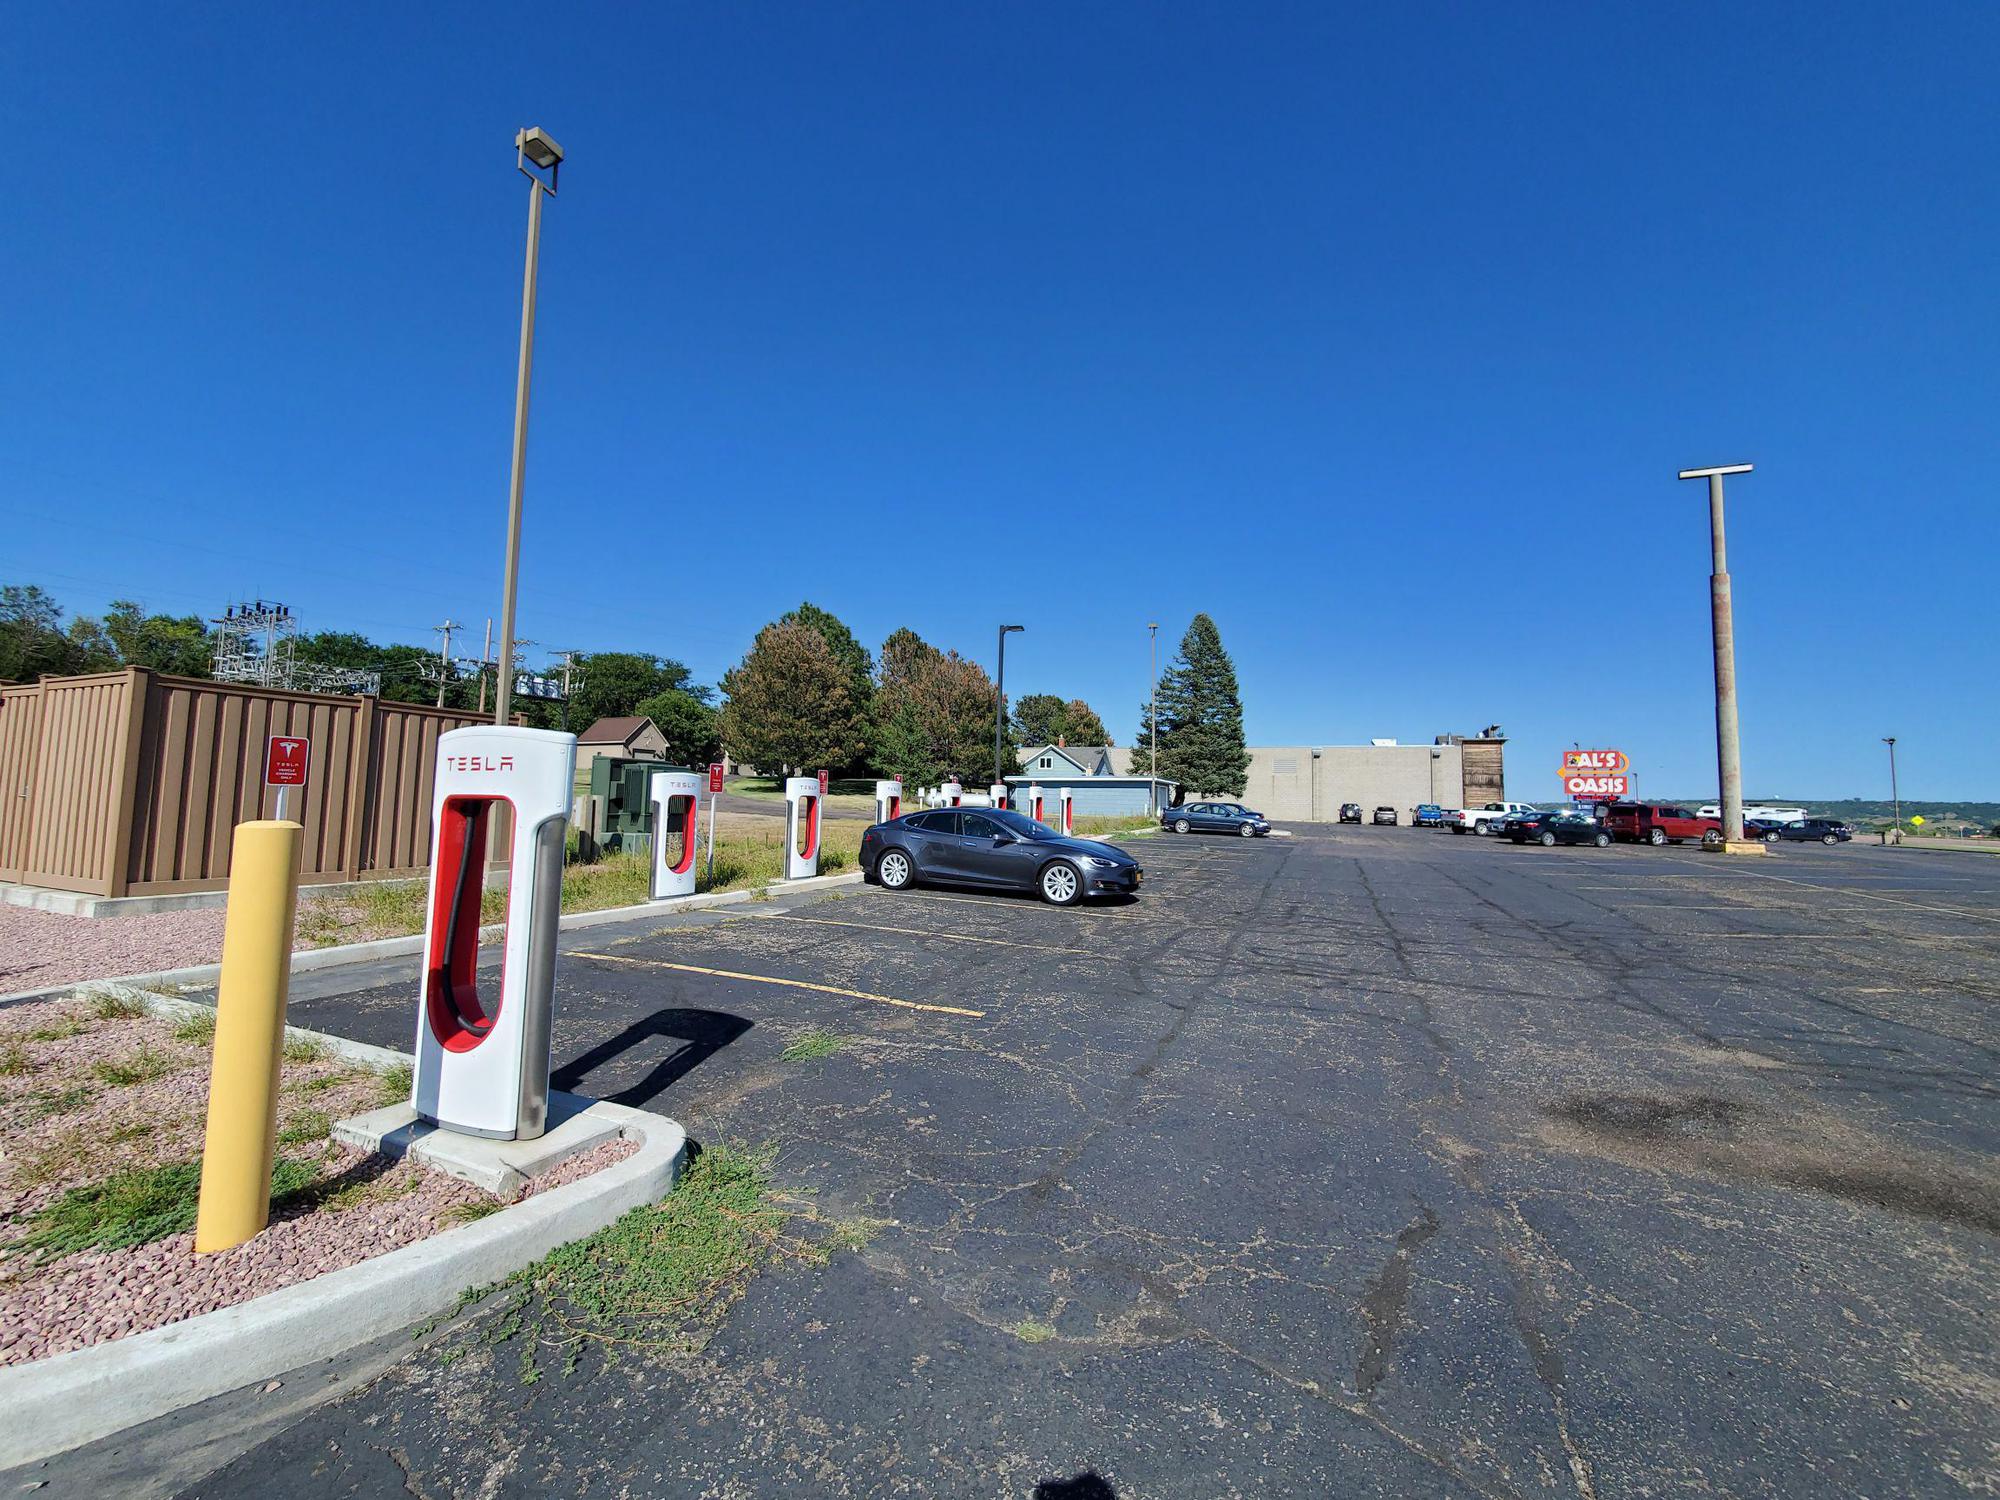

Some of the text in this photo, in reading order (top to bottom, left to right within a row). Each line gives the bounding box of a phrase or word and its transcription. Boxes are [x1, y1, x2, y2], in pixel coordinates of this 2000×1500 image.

[447, 756, 514, 772] TESLA
[1578, 752, 1616, 767] AL'S
[670, 781, 697, 789] TESLA
[1568, 777, 1624, 793] OASIS
